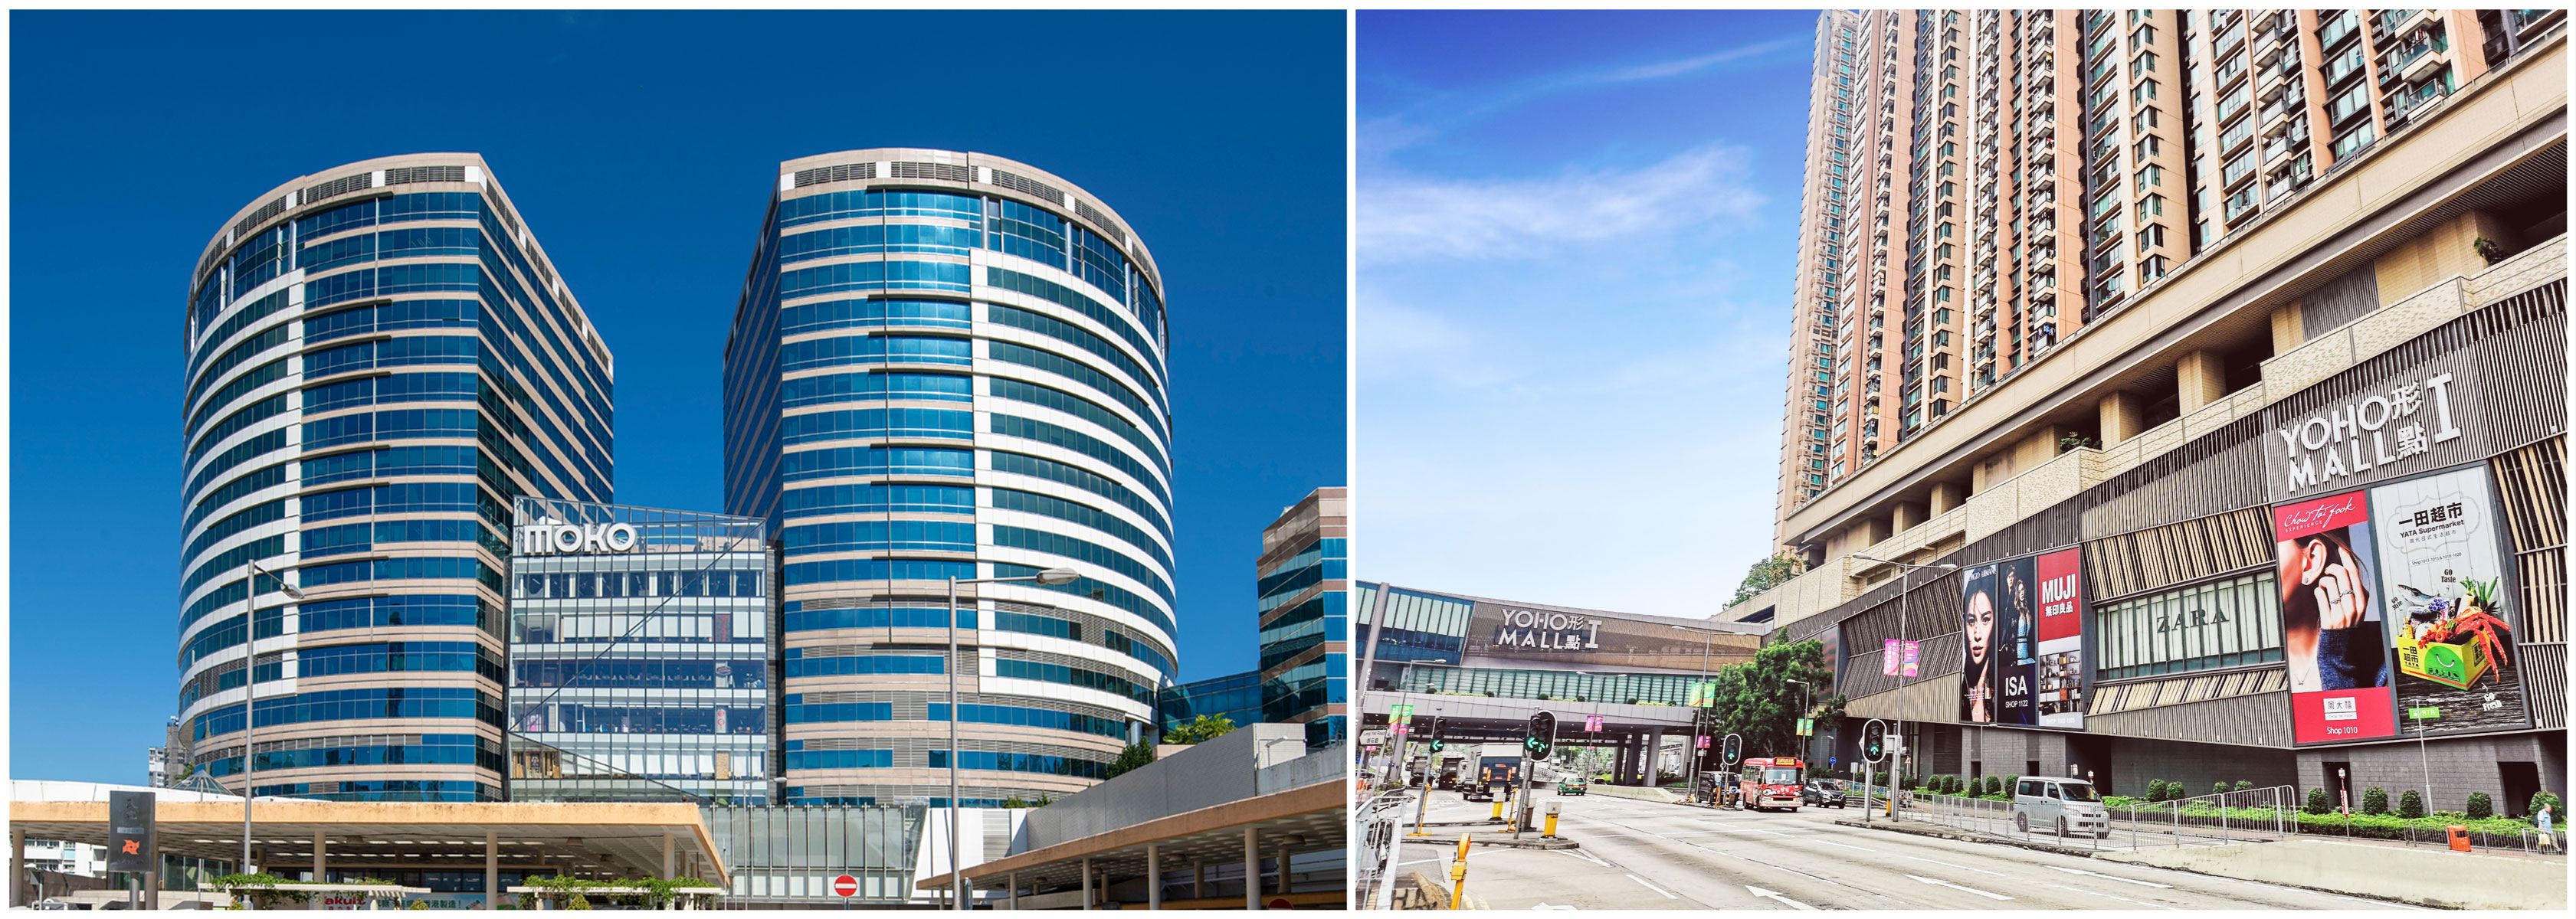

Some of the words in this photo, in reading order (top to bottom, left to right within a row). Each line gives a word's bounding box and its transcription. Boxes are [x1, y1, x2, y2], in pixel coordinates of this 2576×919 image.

[2280, 395, 2391, 457] YOHO
[2289, 430, 2397, 492] MALL
[2284, 511, 2311, 527] Chow
[2310, 505, 2335, 521] Tai
[2399, 502, 2463, 527] 一田超市
[2285, 520, 2322, 533] EXPERIENCE
[2400, 529, 2417, 538] YATA
[2419, 519, 2464, 535] Supermarket
[524, 522, 637, 554] MOKO
[2042, 574, 2076, 604] MUJI
[2045, 600, 2073, 617] 無印良品
[1502, 609, 1568, 630] YOHO
[2157, 608, 2230, 633] ZARA
[1498, 627, 1564, 649] MALL
[2005, 675, 2028, 697] ISA
[2328, 700, 2352, 710] 周大福
[2482, 699, 2502, 711] Fresh
[2484, 692, 2496, 702] GO
[2327, 727, 2342, 735] Shop
[324, 896, 366, 905] akult
